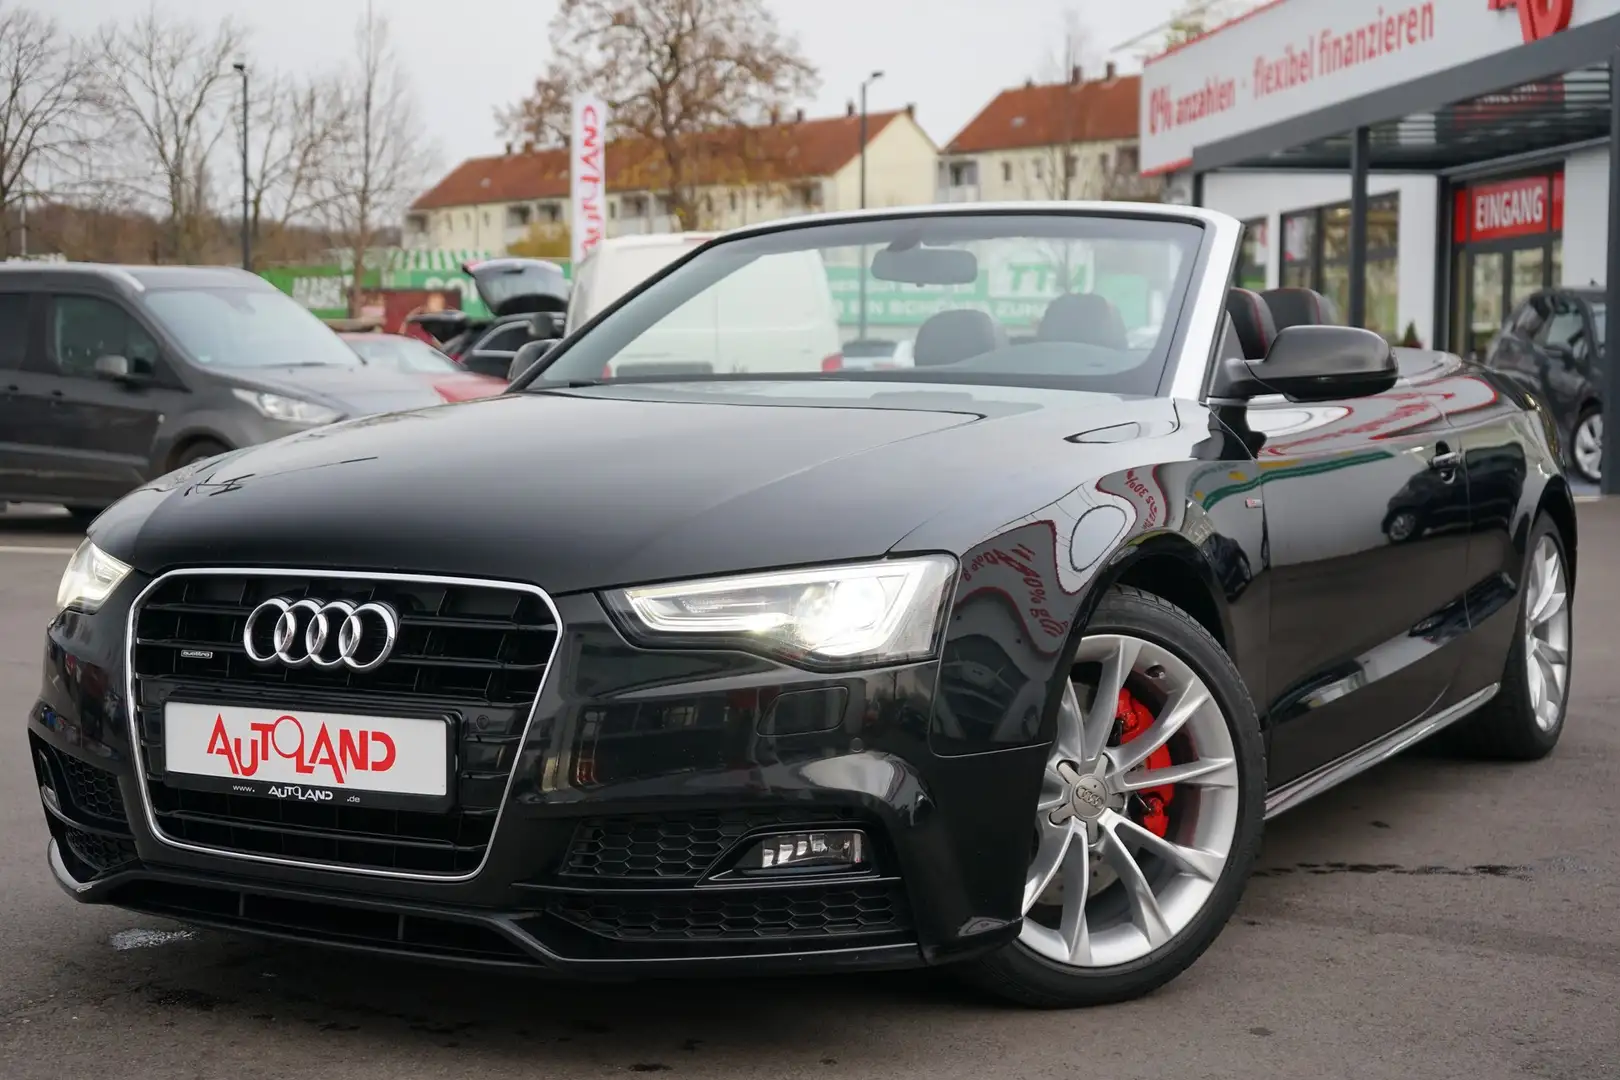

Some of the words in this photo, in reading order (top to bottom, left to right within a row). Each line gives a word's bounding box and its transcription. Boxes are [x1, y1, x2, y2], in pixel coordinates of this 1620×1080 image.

[1149, 85, 1171, 135] 0%
[1176, 77, 1236, 124] anzahlen
[1253, 35, 1314, 100] flexibel
[1318, 2, 1434, 76] finanzieren
[1476, 185, 1543, 232] EINGANG
[207, 713, 396, 784] AUTOLAND
[233, 784, 255, 793] www.
[268, 785, 333, 802] AUTOLAND
